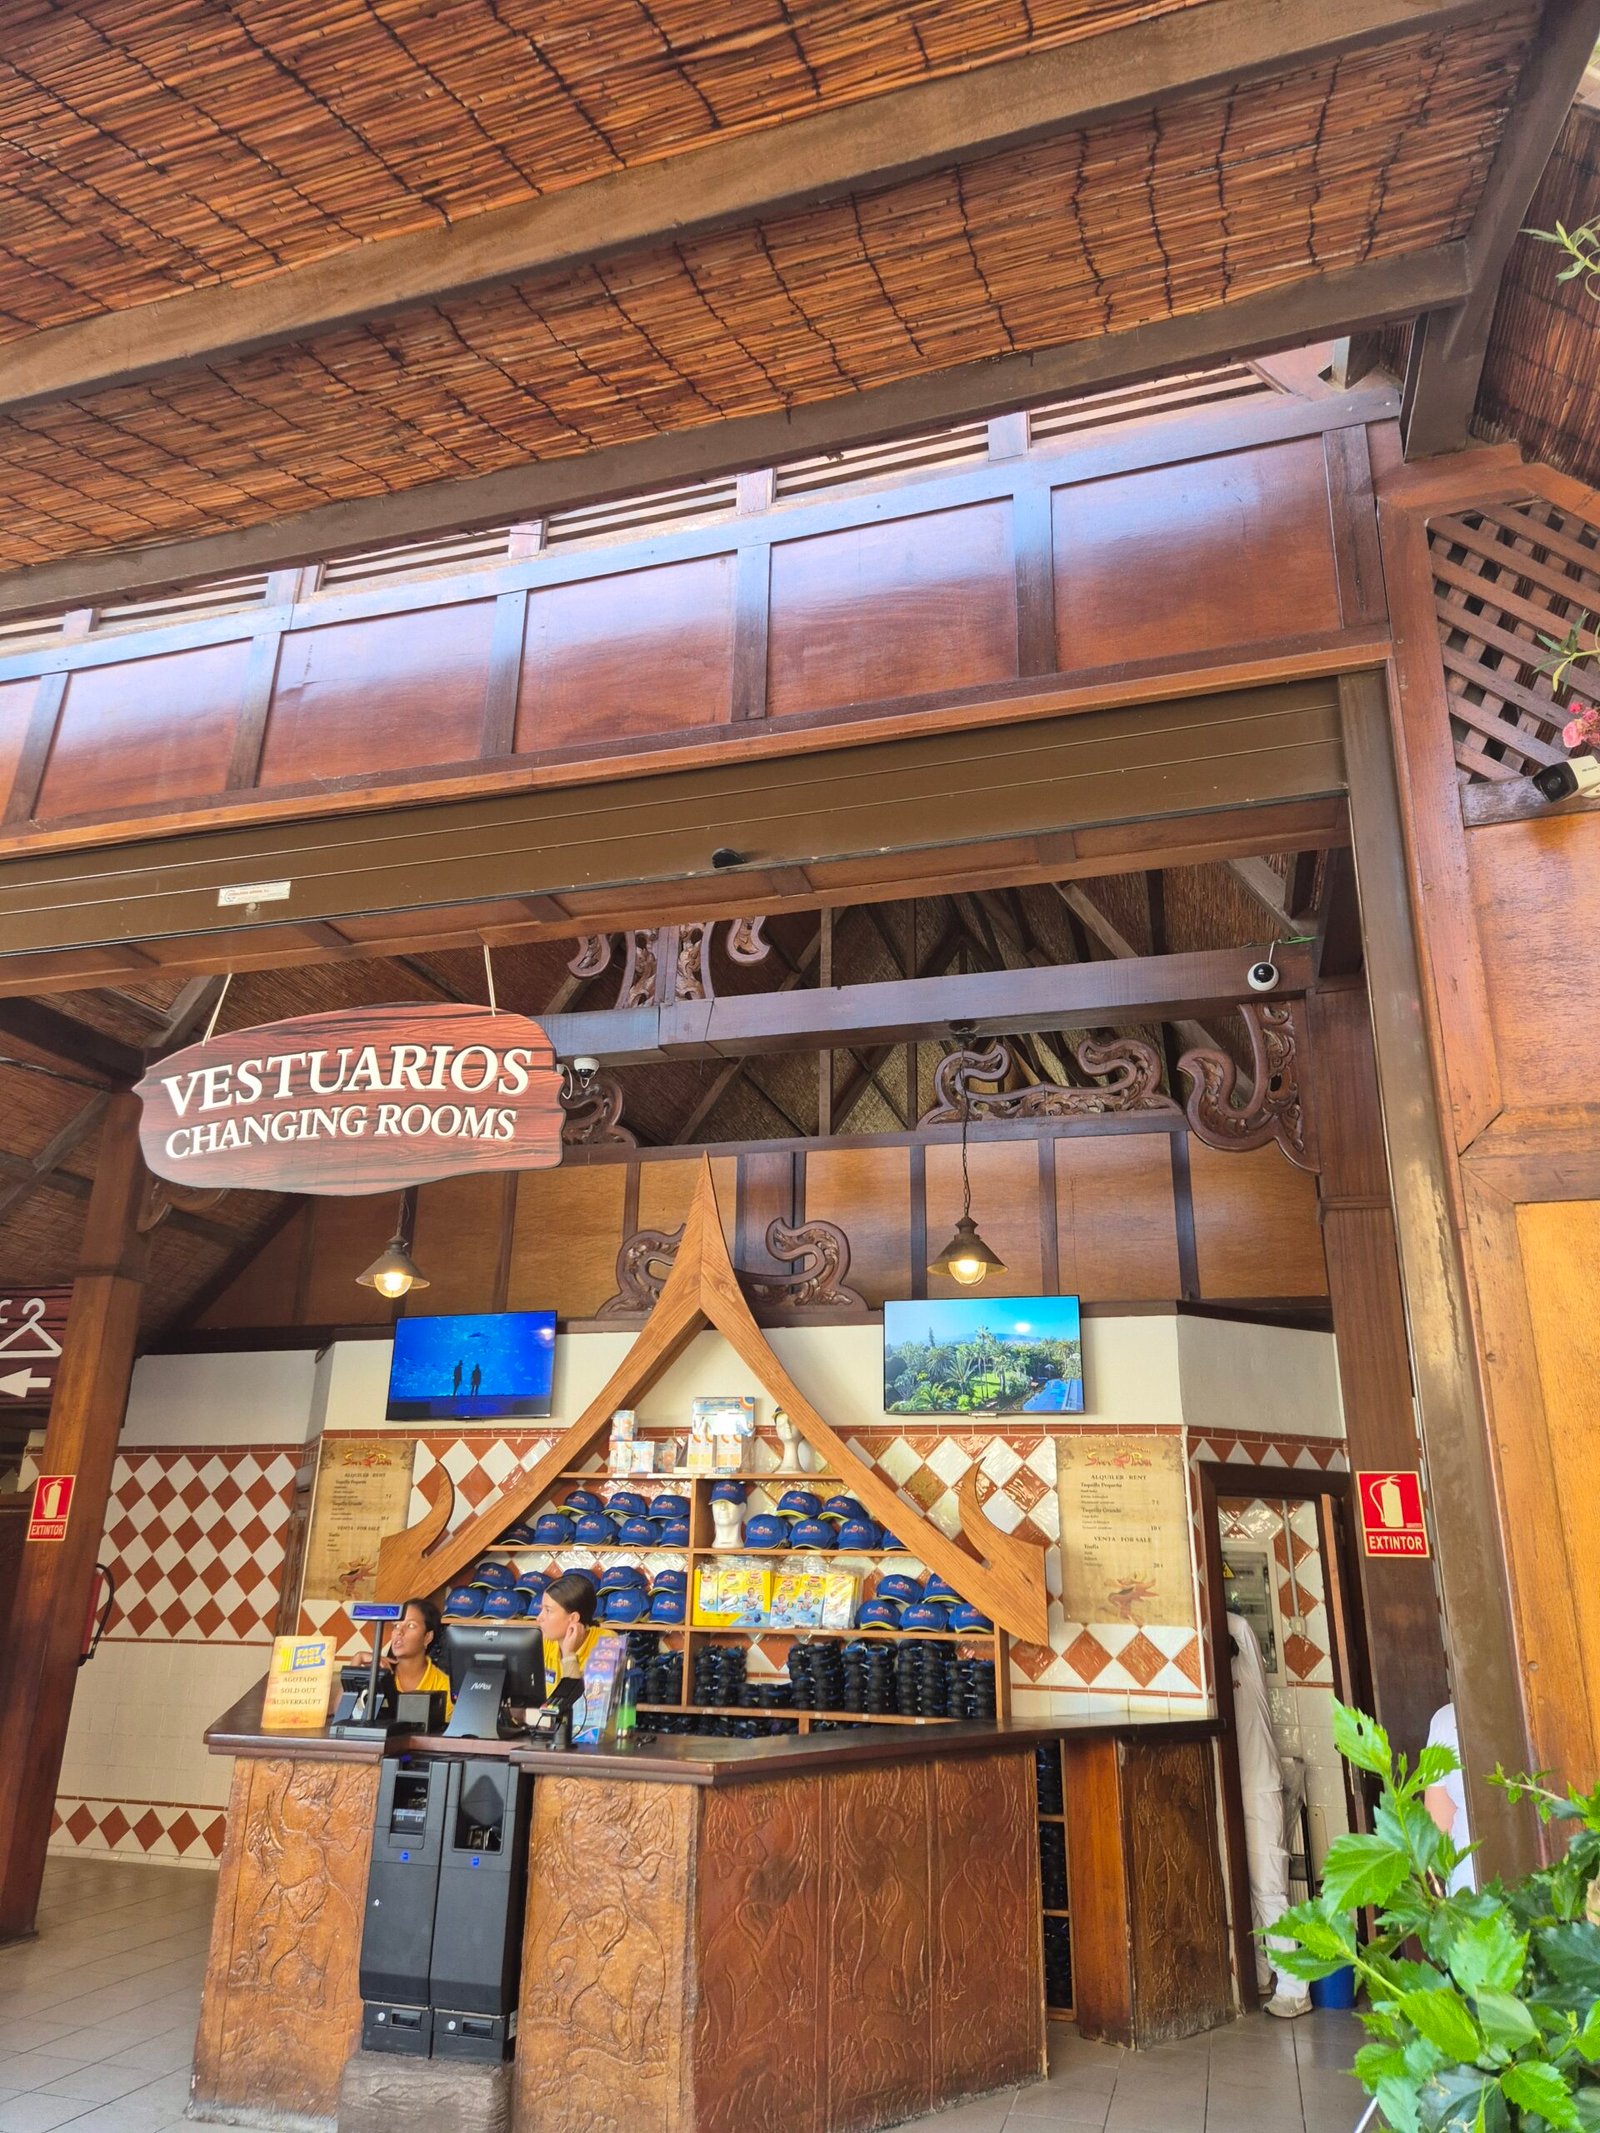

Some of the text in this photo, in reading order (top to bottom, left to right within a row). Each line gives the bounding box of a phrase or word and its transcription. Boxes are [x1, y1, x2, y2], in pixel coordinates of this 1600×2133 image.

[161, 1045, 532, 1116] VESTUARIOS
[164, 1104, 518, 1160] CHANGING ROOMS
[31, 1524, 64, 1536] EXTINTOR
[1368, 1535, 1424, 1550] EXTINTOR
